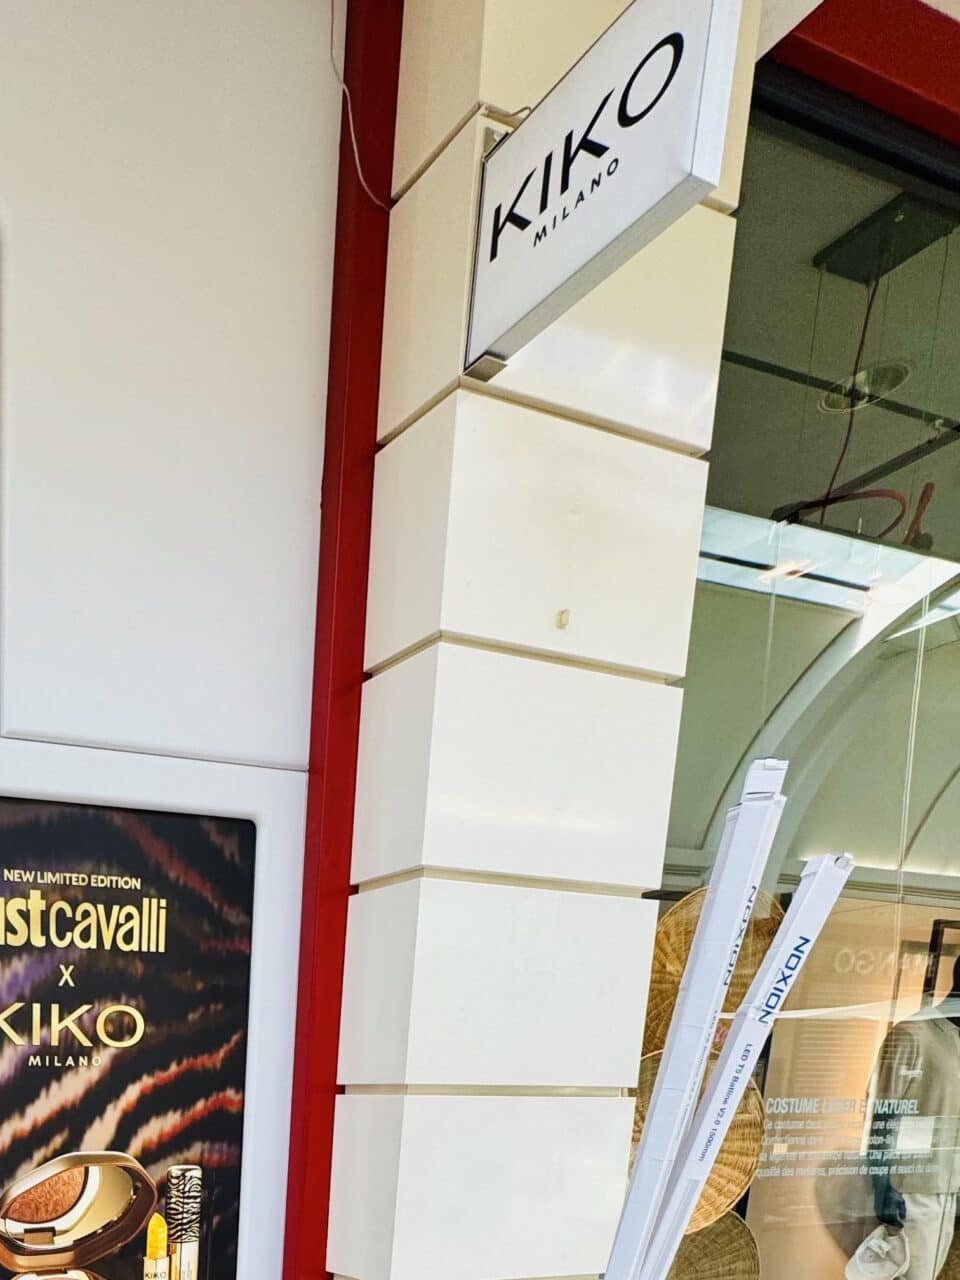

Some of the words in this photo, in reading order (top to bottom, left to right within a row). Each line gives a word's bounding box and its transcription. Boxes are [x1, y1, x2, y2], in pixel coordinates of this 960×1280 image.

[489, 31, 685, 264] KIKO
[532, 157, 620, 249] MILANO
[3, 868, 36, 882] NEW
[37, 871, 89, 886] LIMITED
[90, 874, 142, 890] EDITION
[758, 936, 811, 1024] NOXION
[28, 1055, 103, 1067] MILANO
[766, 1097, 820, 1114] COSTUME
[874, 1099, 920, 1114] NATUREL
